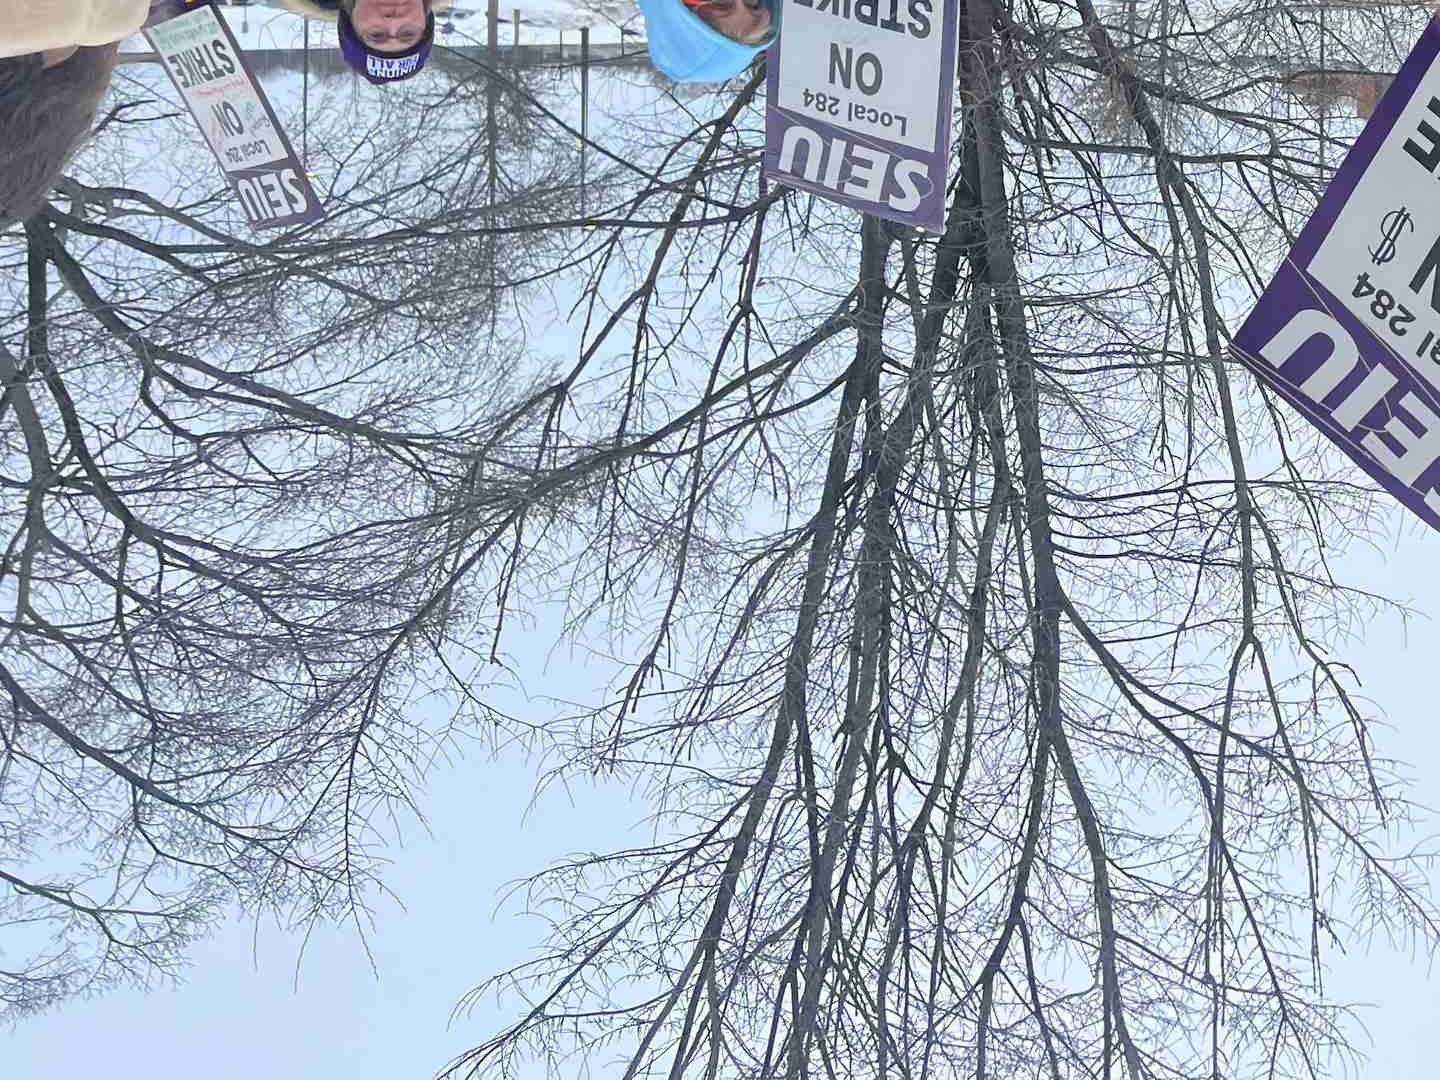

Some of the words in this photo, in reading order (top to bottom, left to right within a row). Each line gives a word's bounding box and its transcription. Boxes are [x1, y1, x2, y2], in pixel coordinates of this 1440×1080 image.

[167, 39, 235, 88] STRIKE
[829, 42, 883, 96] ON
[211, 101, 244, 137] ON
[802, 87, 840, 116] 284
[848, 101, 908, 137] Local
[241, 140, 271, 161] Local
[778, 125, 930, 212] SEIU
[237, 168, 307, 221] SEIU
[1367, 207, 1414, 266] $
[1351, 271, 1416, 337] 284
